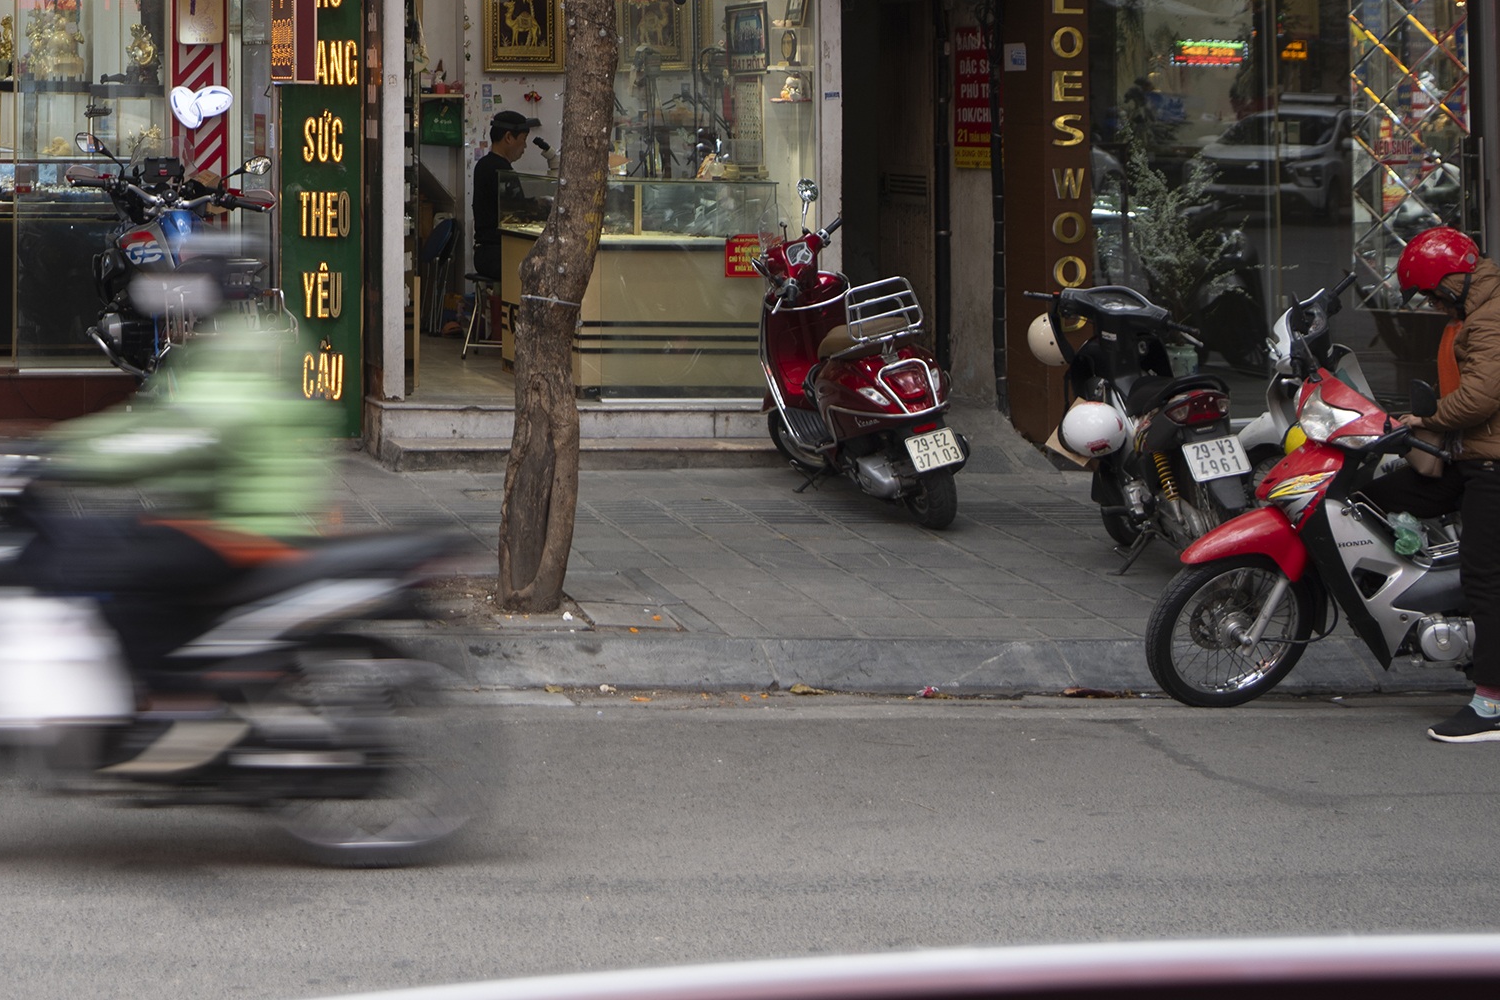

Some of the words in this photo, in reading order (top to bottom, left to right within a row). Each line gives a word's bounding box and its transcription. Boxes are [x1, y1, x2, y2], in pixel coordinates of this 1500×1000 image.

[316, 40, 358, 85] ANG
[960, 80, 979, 99] PHÚ
[303, 109, 344, 163] SỨC
[300, 190, 351, 238] THEO
[302, 261, 343, 319] YÊU
[303, 335, 344, 400] CẦU
[913, 432, 950, 454] 29-E2
[1192, 438, 1235, 461] 29-V3
[915, 446, 960, 469] 371.03
[1200, 455, 1242, 477] 4961
[1338, 539, 1374, 548] HONDA
